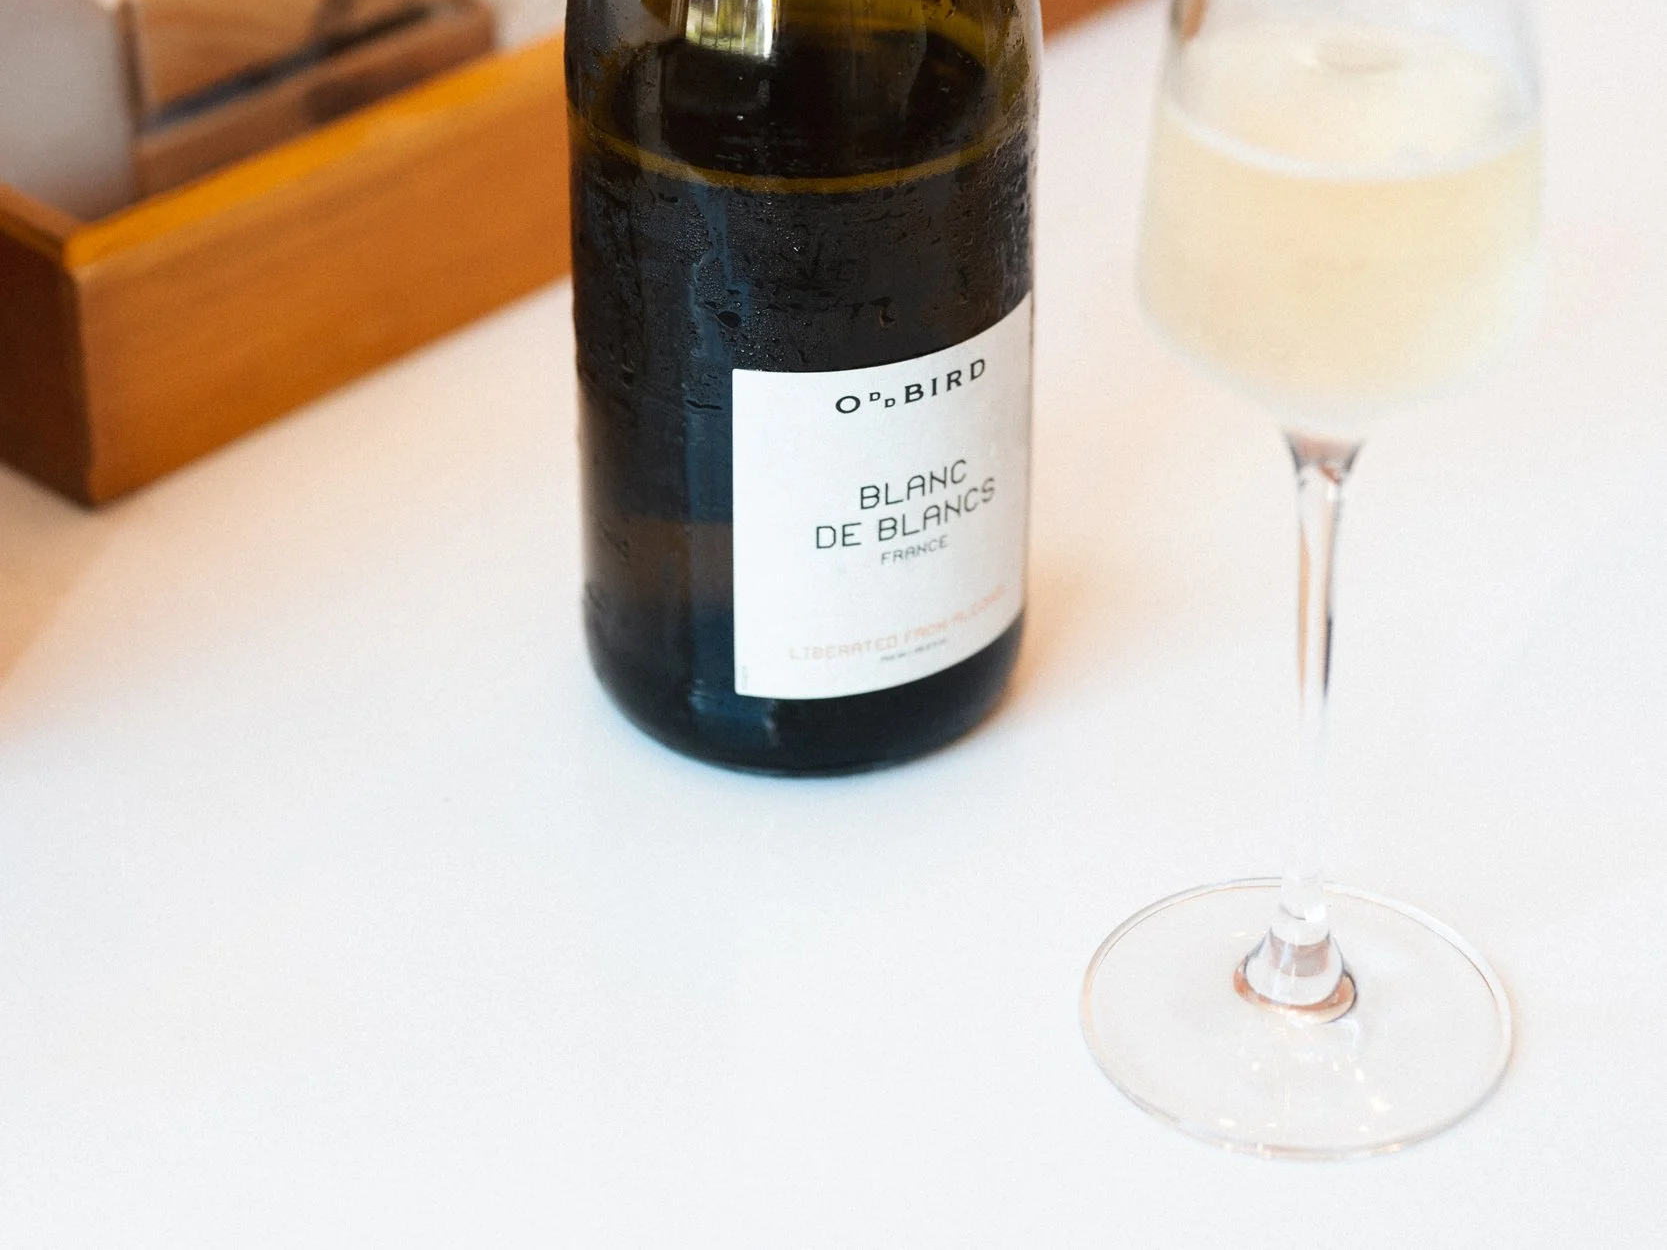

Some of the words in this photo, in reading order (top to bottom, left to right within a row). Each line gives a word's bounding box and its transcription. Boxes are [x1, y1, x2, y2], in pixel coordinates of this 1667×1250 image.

[835, 358, 986, 414] ODDBIRD
[859, 458, 967, 510] BLANC
[815, 522, 862, 549] DE
[878, 477, 996, 542] BLANCS
[881, 534, 949, 565] FRANCE
[788, 635, 898, 660] LIBERATED
